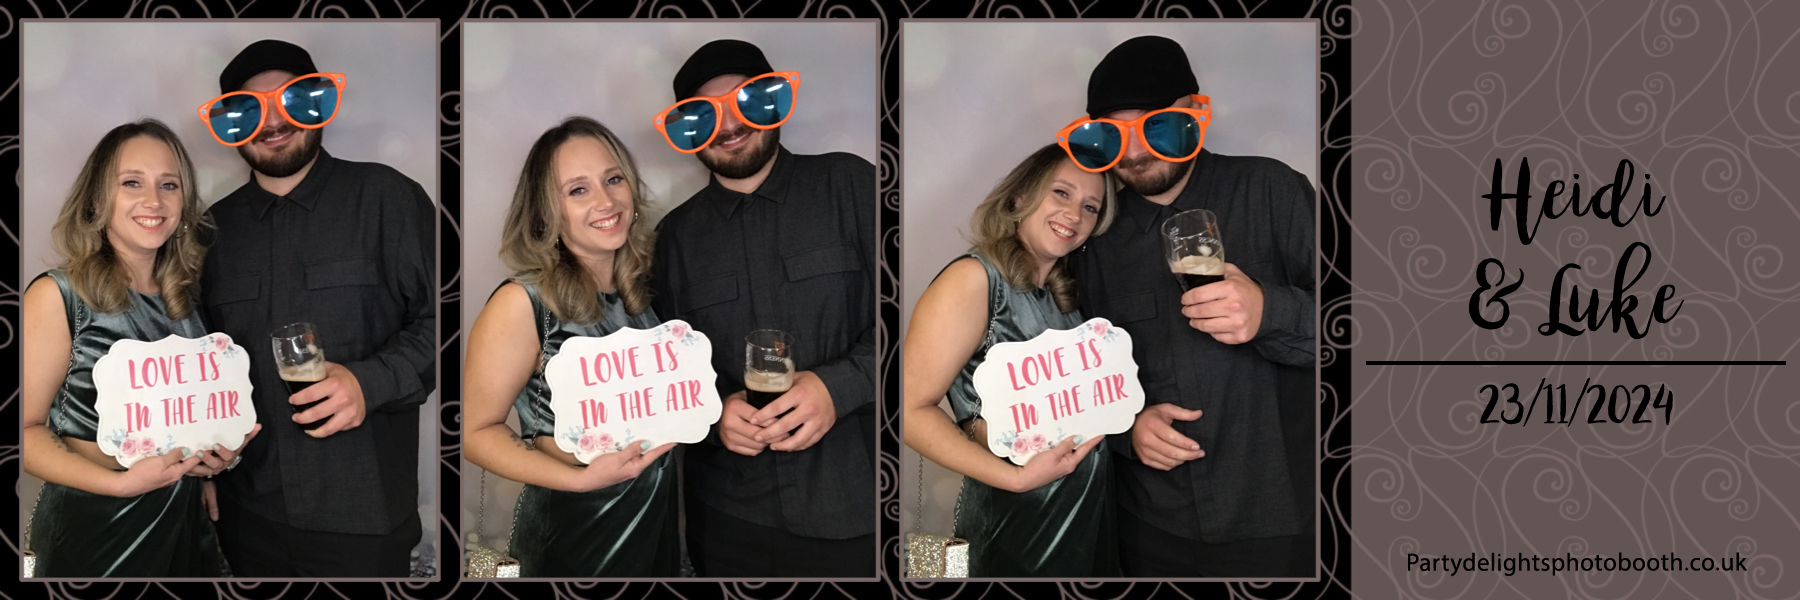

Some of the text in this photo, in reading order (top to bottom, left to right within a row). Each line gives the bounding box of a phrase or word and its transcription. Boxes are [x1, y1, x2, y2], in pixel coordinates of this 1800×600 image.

[128, 351, 221, 390] LOVE IS
[579, 340, 679, 387] LOVE IS
[1007, 338, 1102, 391] LOVE IS
[160, 394, 197, 427] THE
[206, 390, 241, 420] AIR
[616, 387, 657, 422] THE
[666, 379, 705, 412] AIR
[1045, 385, 1085, 421] THE
[1093, 373, 1129, 407] AIR
